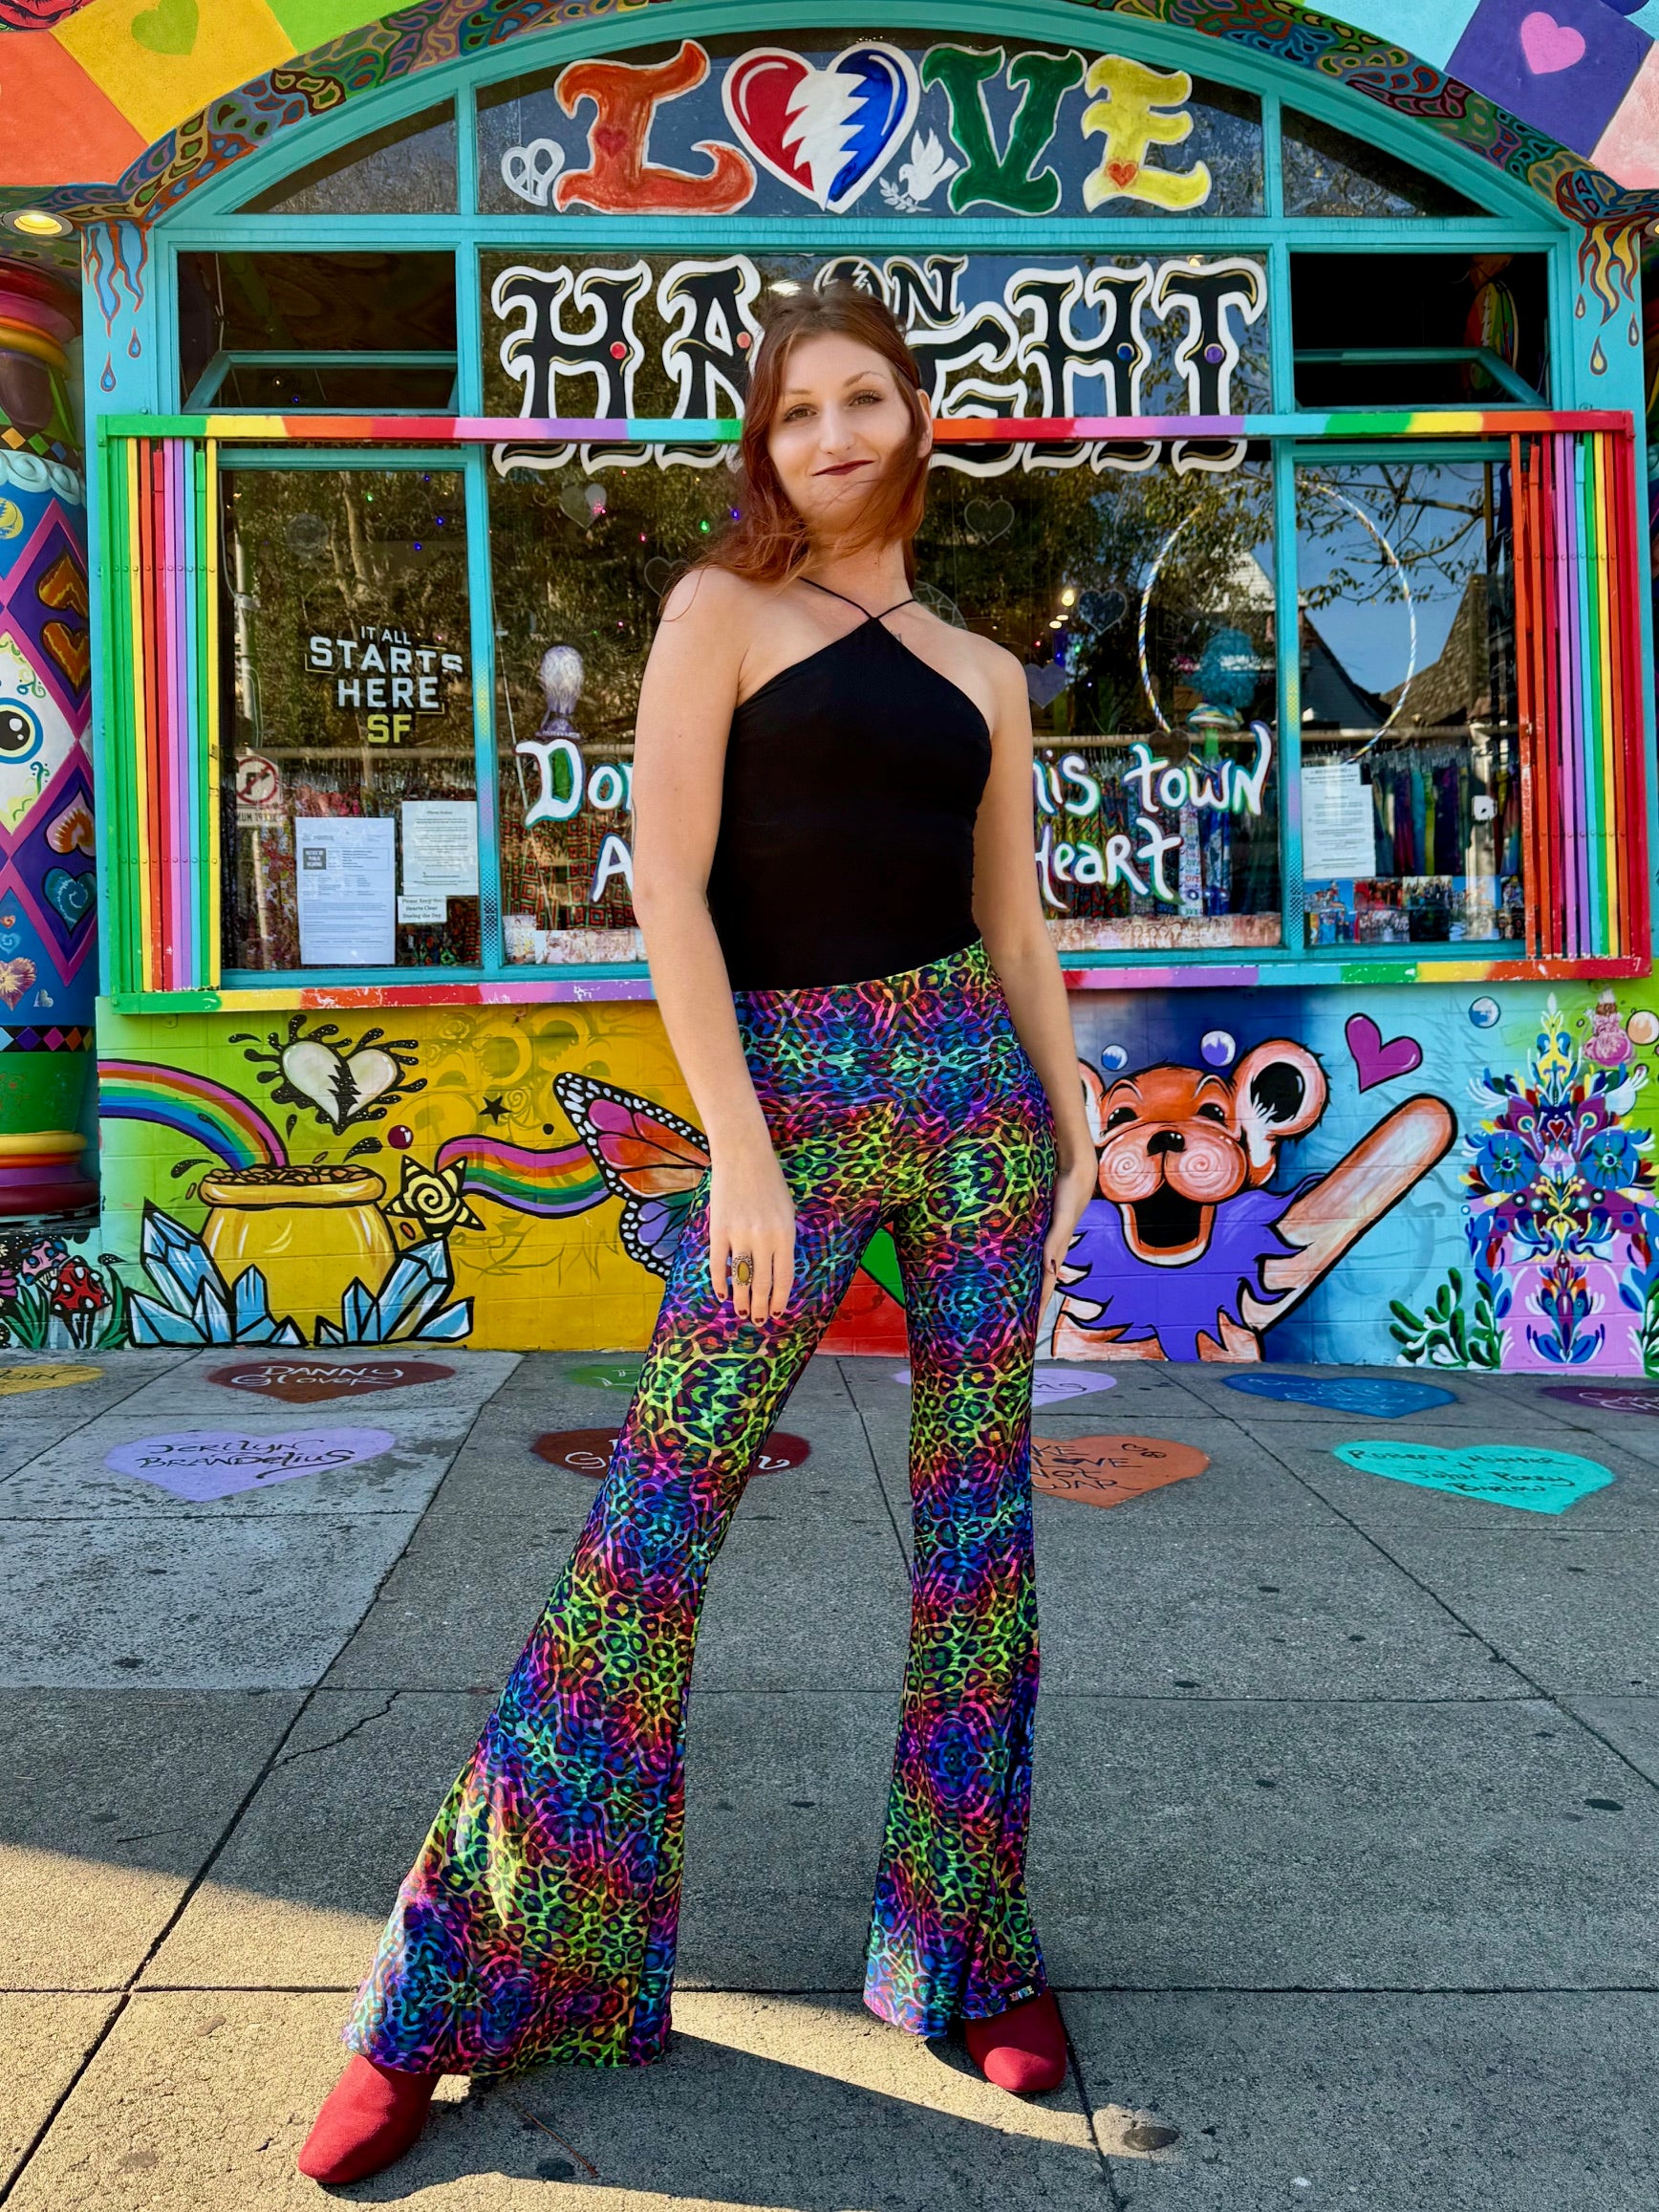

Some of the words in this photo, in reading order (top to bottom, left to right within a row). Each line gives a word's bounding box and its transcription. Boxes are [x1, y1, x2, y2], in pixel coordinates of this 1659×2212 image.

[360, 626, 376, 640] IT
[381, 628, 412, 645] ALL
[310, 636, 463, 674] STARTS
[337, 676, 440, 709] HERE
[367, 713, 412, 744] SF
